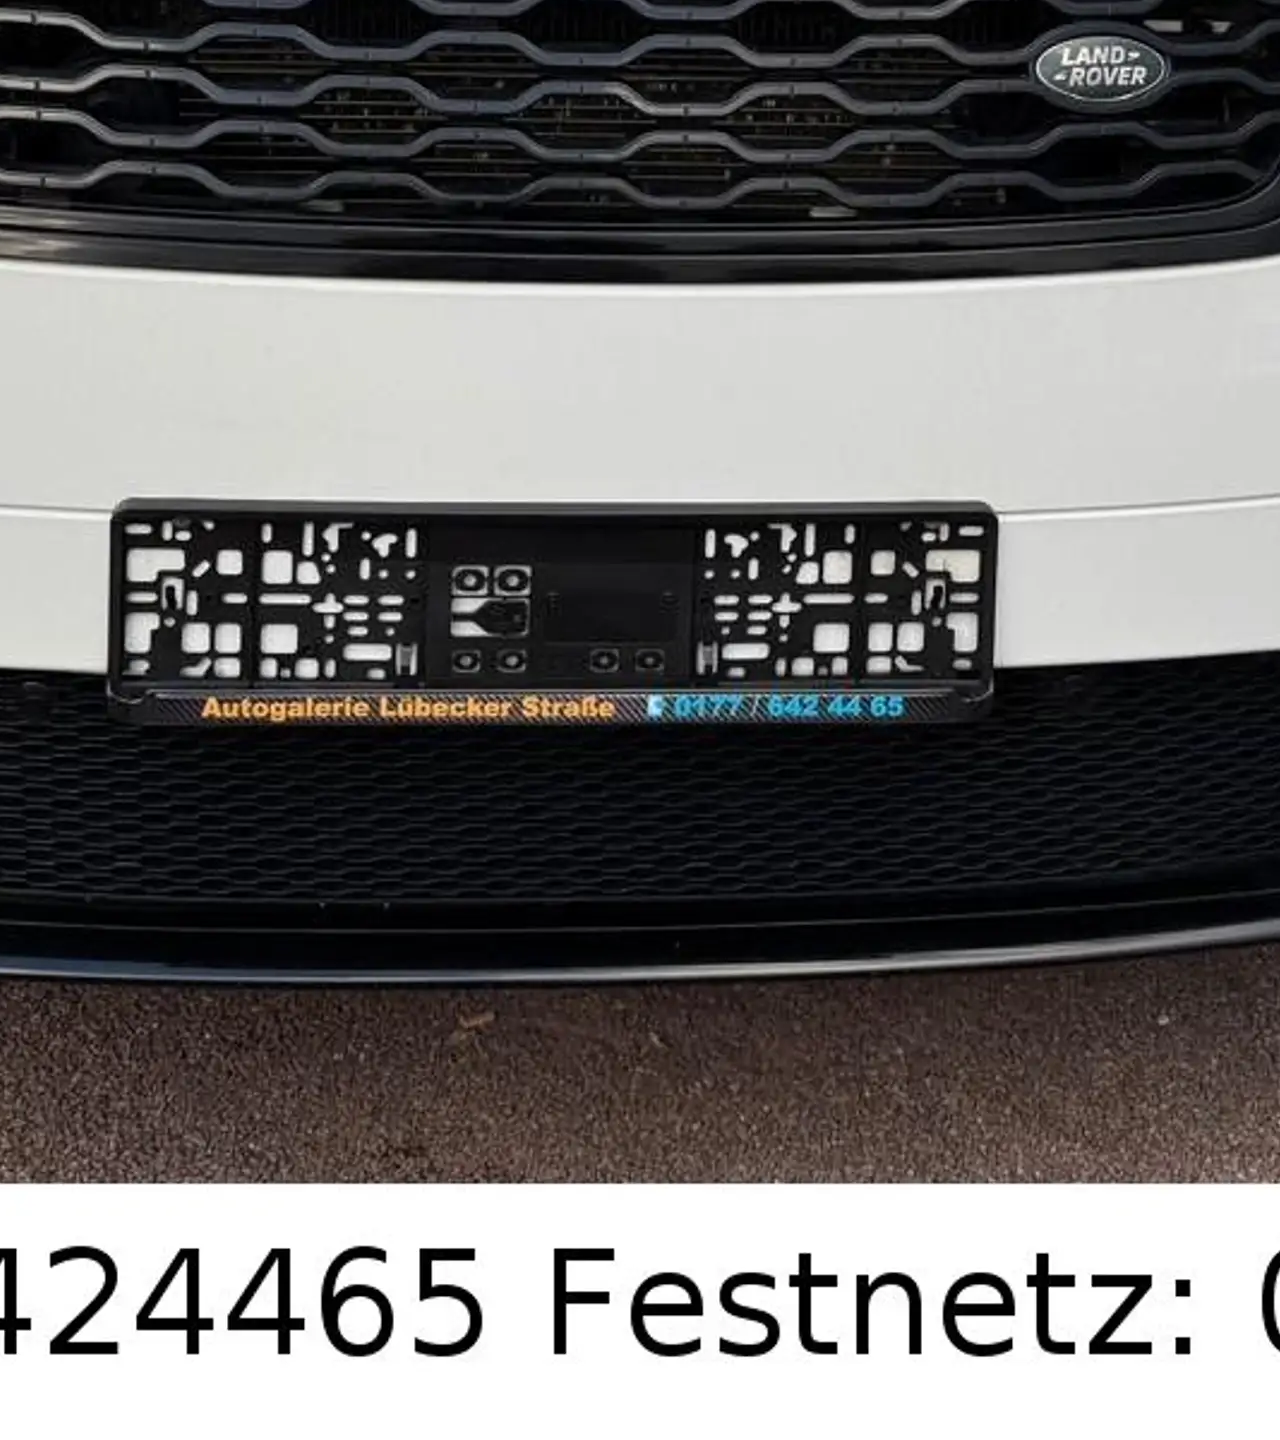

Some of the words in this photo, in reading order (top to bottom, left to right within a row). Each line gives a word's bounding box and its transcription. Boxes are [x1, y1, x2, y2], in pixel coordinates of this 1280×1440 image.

[201, 696, 371, 723] Autogalerie
[379, 696, 511, 719] Lübecker
[521, 696, 616, 719] Straße
[673, 694, 743, 717] 0177
[767, 694, 820, 717] 642
[827, 694, 863, 717] 44
[870, 694, 904, 717] 65
